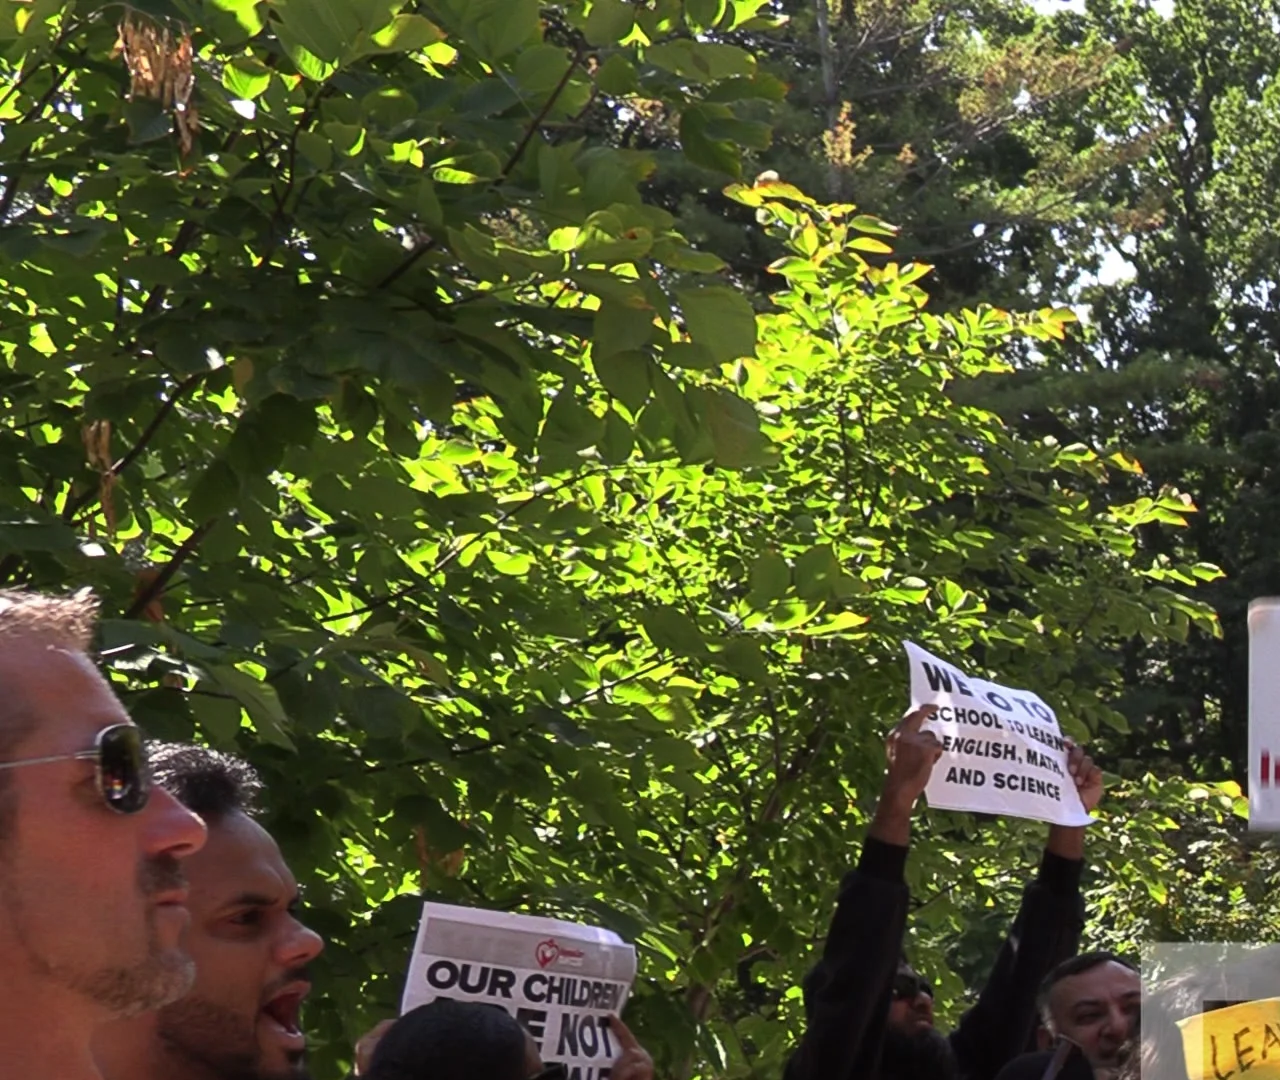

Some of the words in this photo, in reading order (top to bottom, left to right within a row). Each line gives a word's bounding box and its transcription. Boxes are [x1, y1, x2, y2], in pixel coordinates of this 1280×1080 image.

[922, 661, 973, 697] WE
[1012, 696, 1053, 724] TO
[926, 706, 1003, 731] SCHOOL
[1027, 724, 1065, 753] LEARN
[942, 735, 1023, 765] ENGLISH,
[1026, 748, 1065, 779] MATH,
[945, 766, 986, 788] AND
[993, 772, 1061, 802] SCIENCE
[427, 961, 516, 1000] OUR
[523, 974, 626, 1010] CHILDREN
[556, 1012, 613, 1058] NOT
